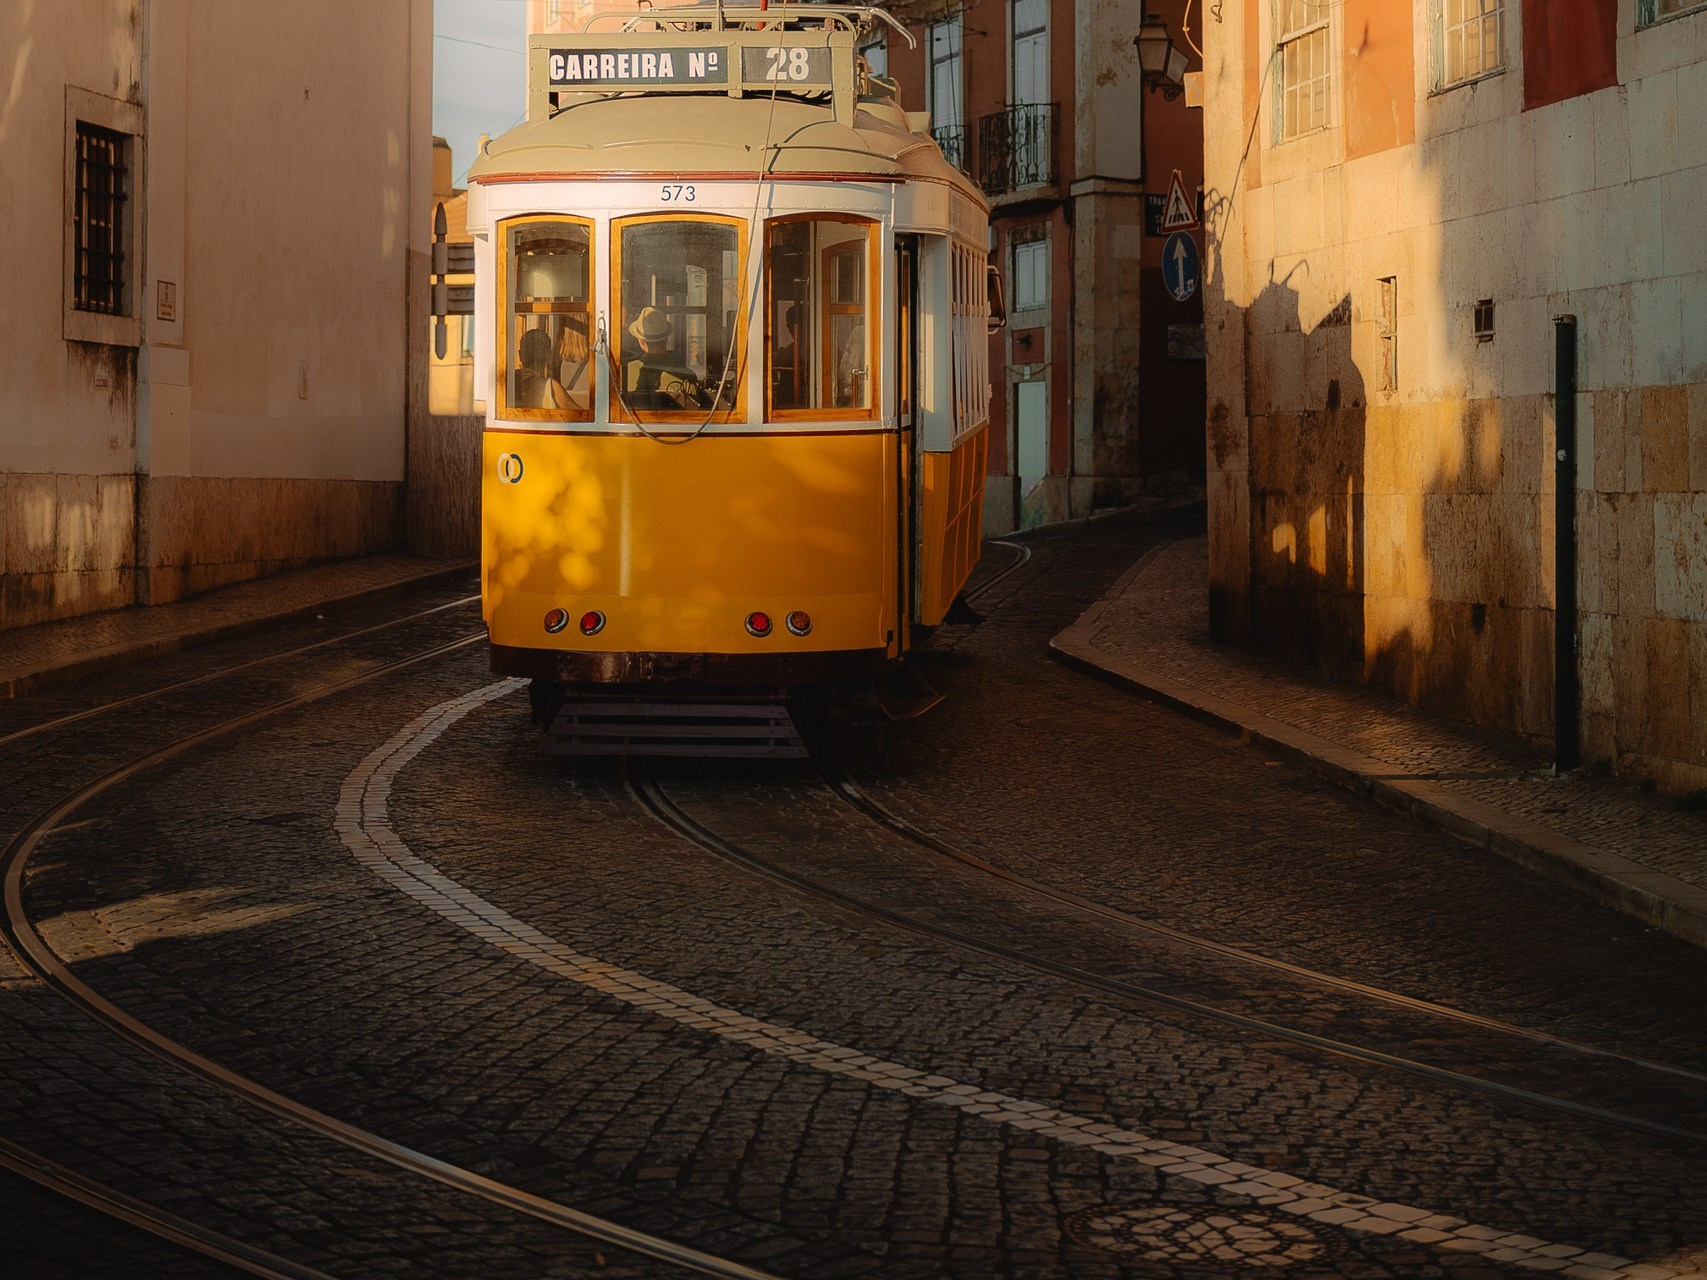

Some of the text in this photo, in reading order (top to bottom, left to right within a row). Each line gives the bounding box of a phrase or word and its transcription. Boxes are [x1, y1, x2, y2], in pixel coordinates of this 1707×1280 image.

[550, 53, 674, 80] CARREIRA
[766, 47, 809, 80] 28
[660, 185, 696, 202] 573
